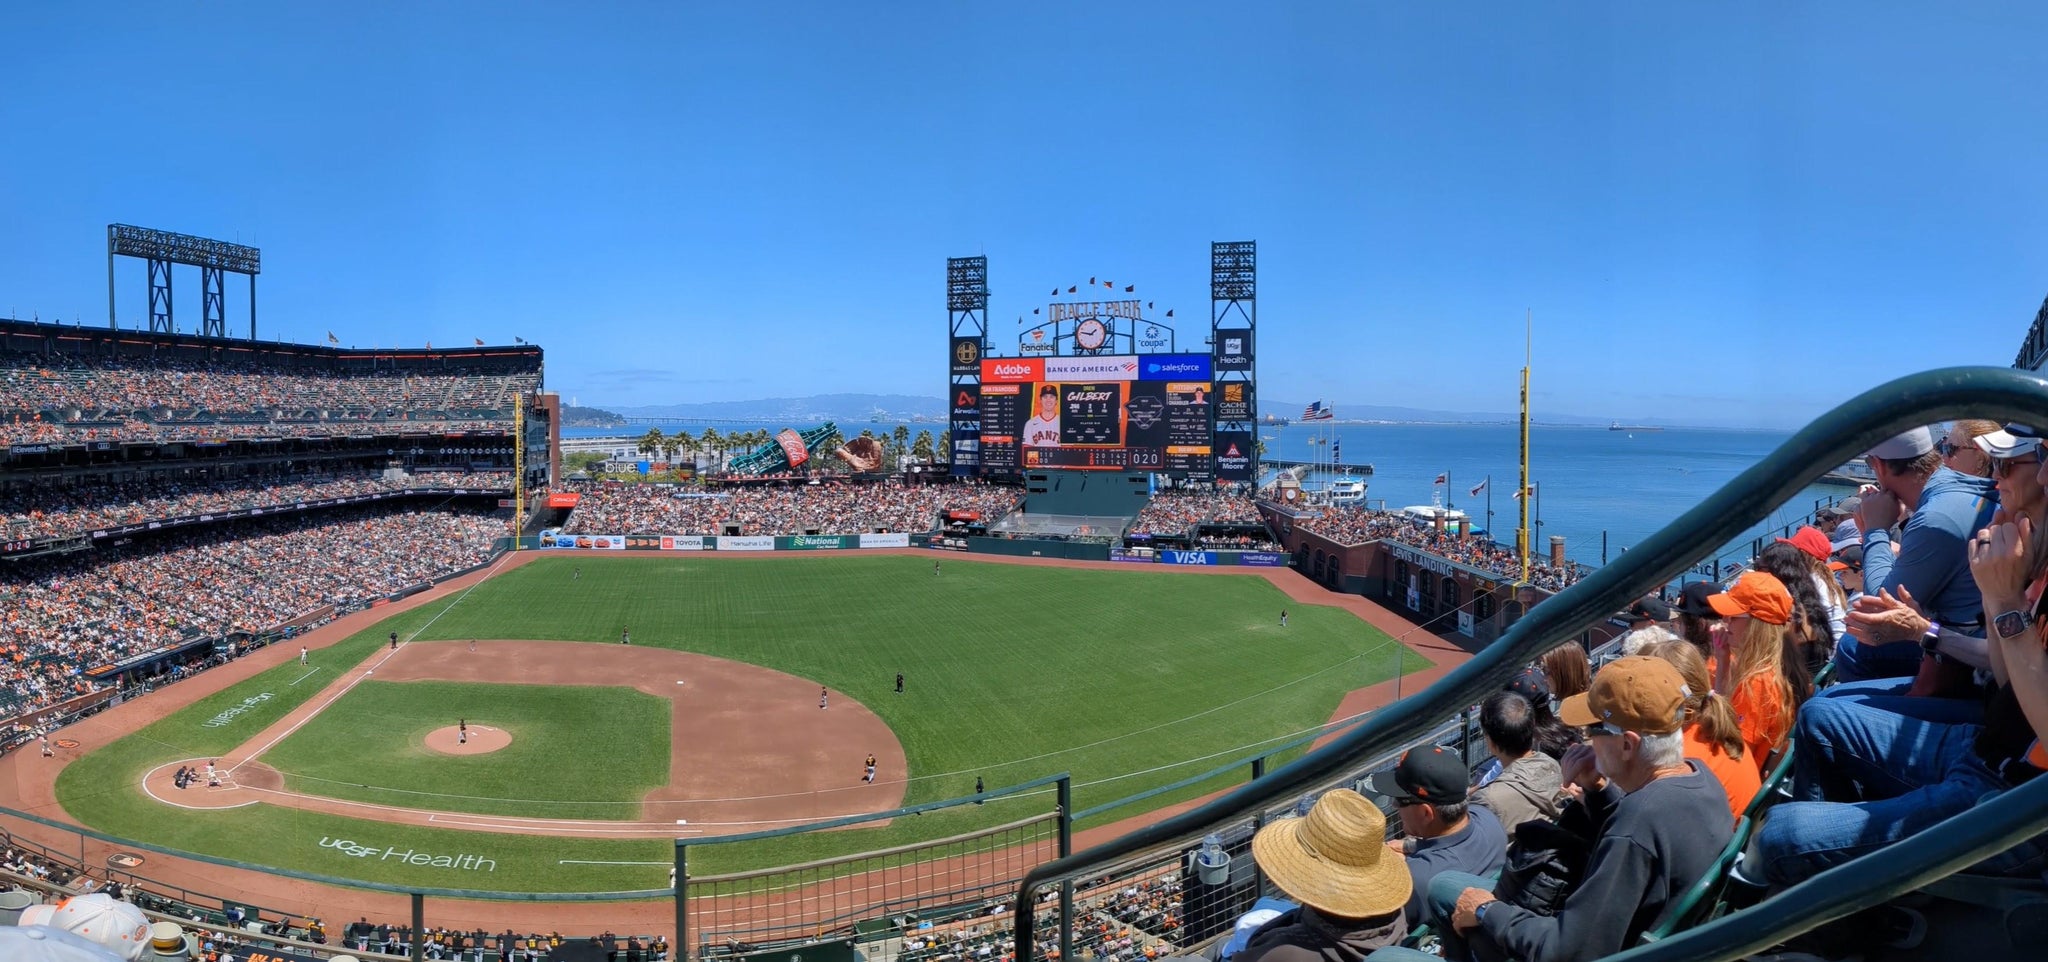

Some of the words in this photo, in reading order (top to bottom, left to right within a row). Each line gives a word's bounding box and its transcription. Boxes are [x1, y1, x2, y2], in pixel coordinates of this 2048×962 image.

[1049, 302, 1101, 322] ORACLE
[1105, 301, 1141, 320] PARK
[1020, 343, 1056, 352] Fanatics
[1140, 340, 1164, 349] coupa
[1220, 356, 1247, 364] Health
[994, 364, 1031, 375] Adobe
[1162, 362, 1200, 373] salesforce
[1067, 391, 1113, 401] GILBERT
[606, 461, 636, 473] blue
[1218, 457, 1249, 466] Benjamin
[805, 537, 840, 545] National
[1174, 552, 1207, 564] VISA
[1415, 554, 1454, 577] LANDING
[201, 704, 255, 728] Health
[319, 837, 382, 858] UCSF
[381, 847, 496, 872] Health
